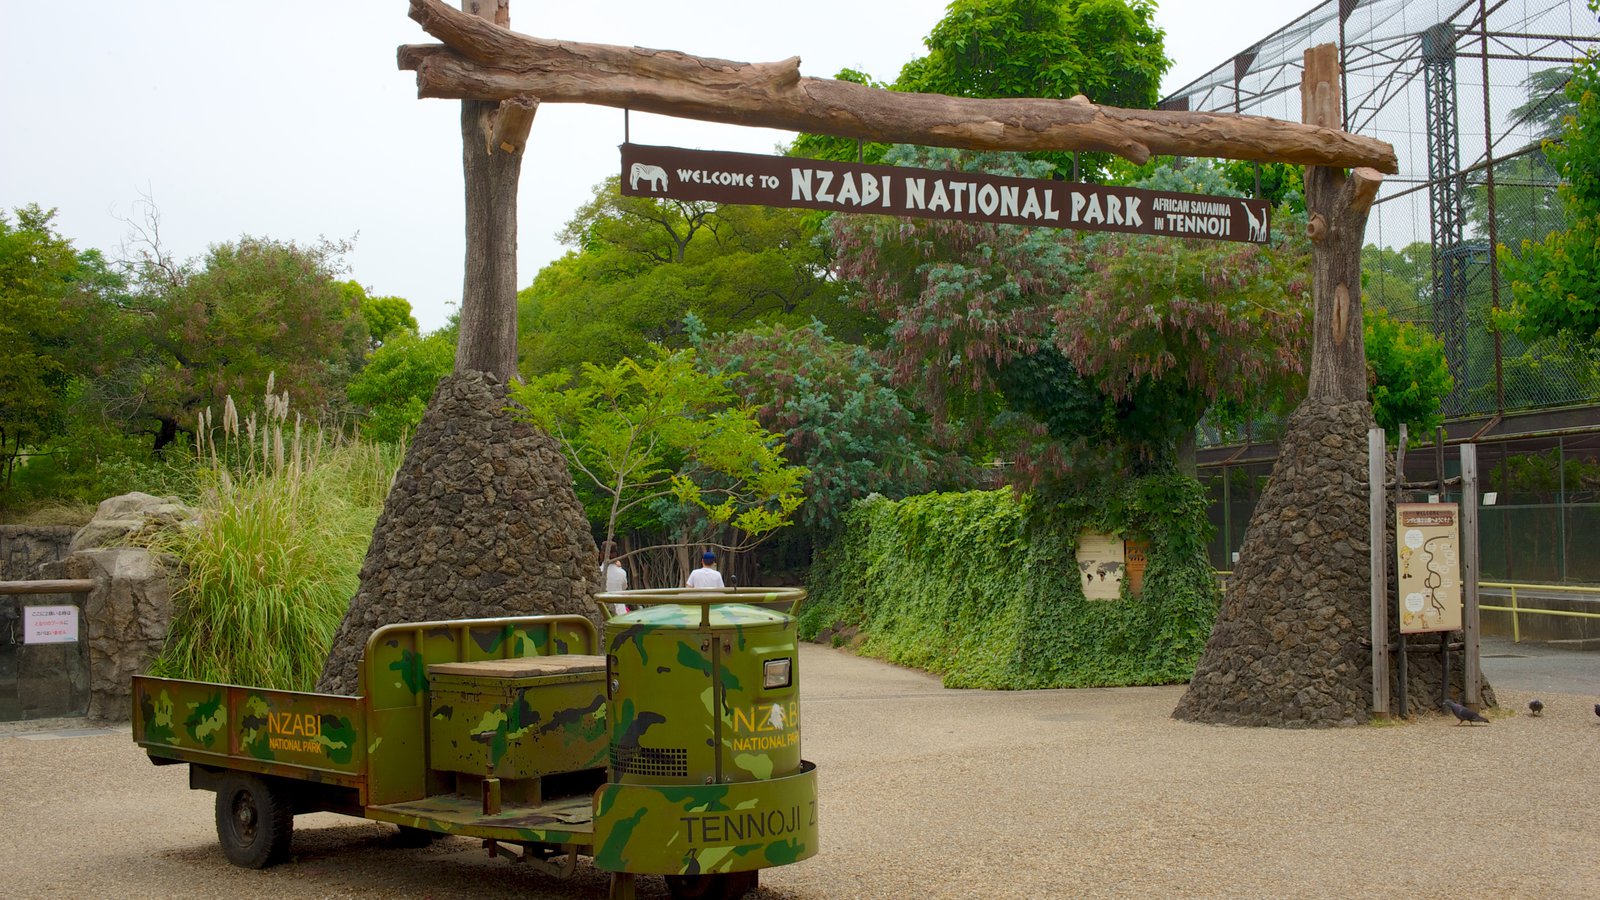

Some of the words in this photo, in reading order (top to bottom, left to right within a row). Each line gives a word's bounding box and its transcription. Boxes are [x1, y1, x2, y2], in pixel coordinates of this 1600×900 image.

[676, 168, 754, 188] WELCOME
[759, 175, 779, 189] TO
[791, 167, 891, 207] NZABI
[905, 177, 1060, 221] NATIONAL
[1070, 191, 1143, 227] PARK
[1152, 197, 1190, 213] AFRICAN
[1190, 200, 1231, 217] SAVANNA
[1154, 217, 1164, 230] IN
[1166, 213, 1231, 237] TENNOJI
[268, 711, 321, 737] NZABI
[733, 702, 799, 733] NZAB
[269, 737, 302, 751] NATIONAL
[302, 740, 321, 754] PARK
[733, 734, 786, 751] NATIONAL
[680, 805, 800, 843] TENNOJI
